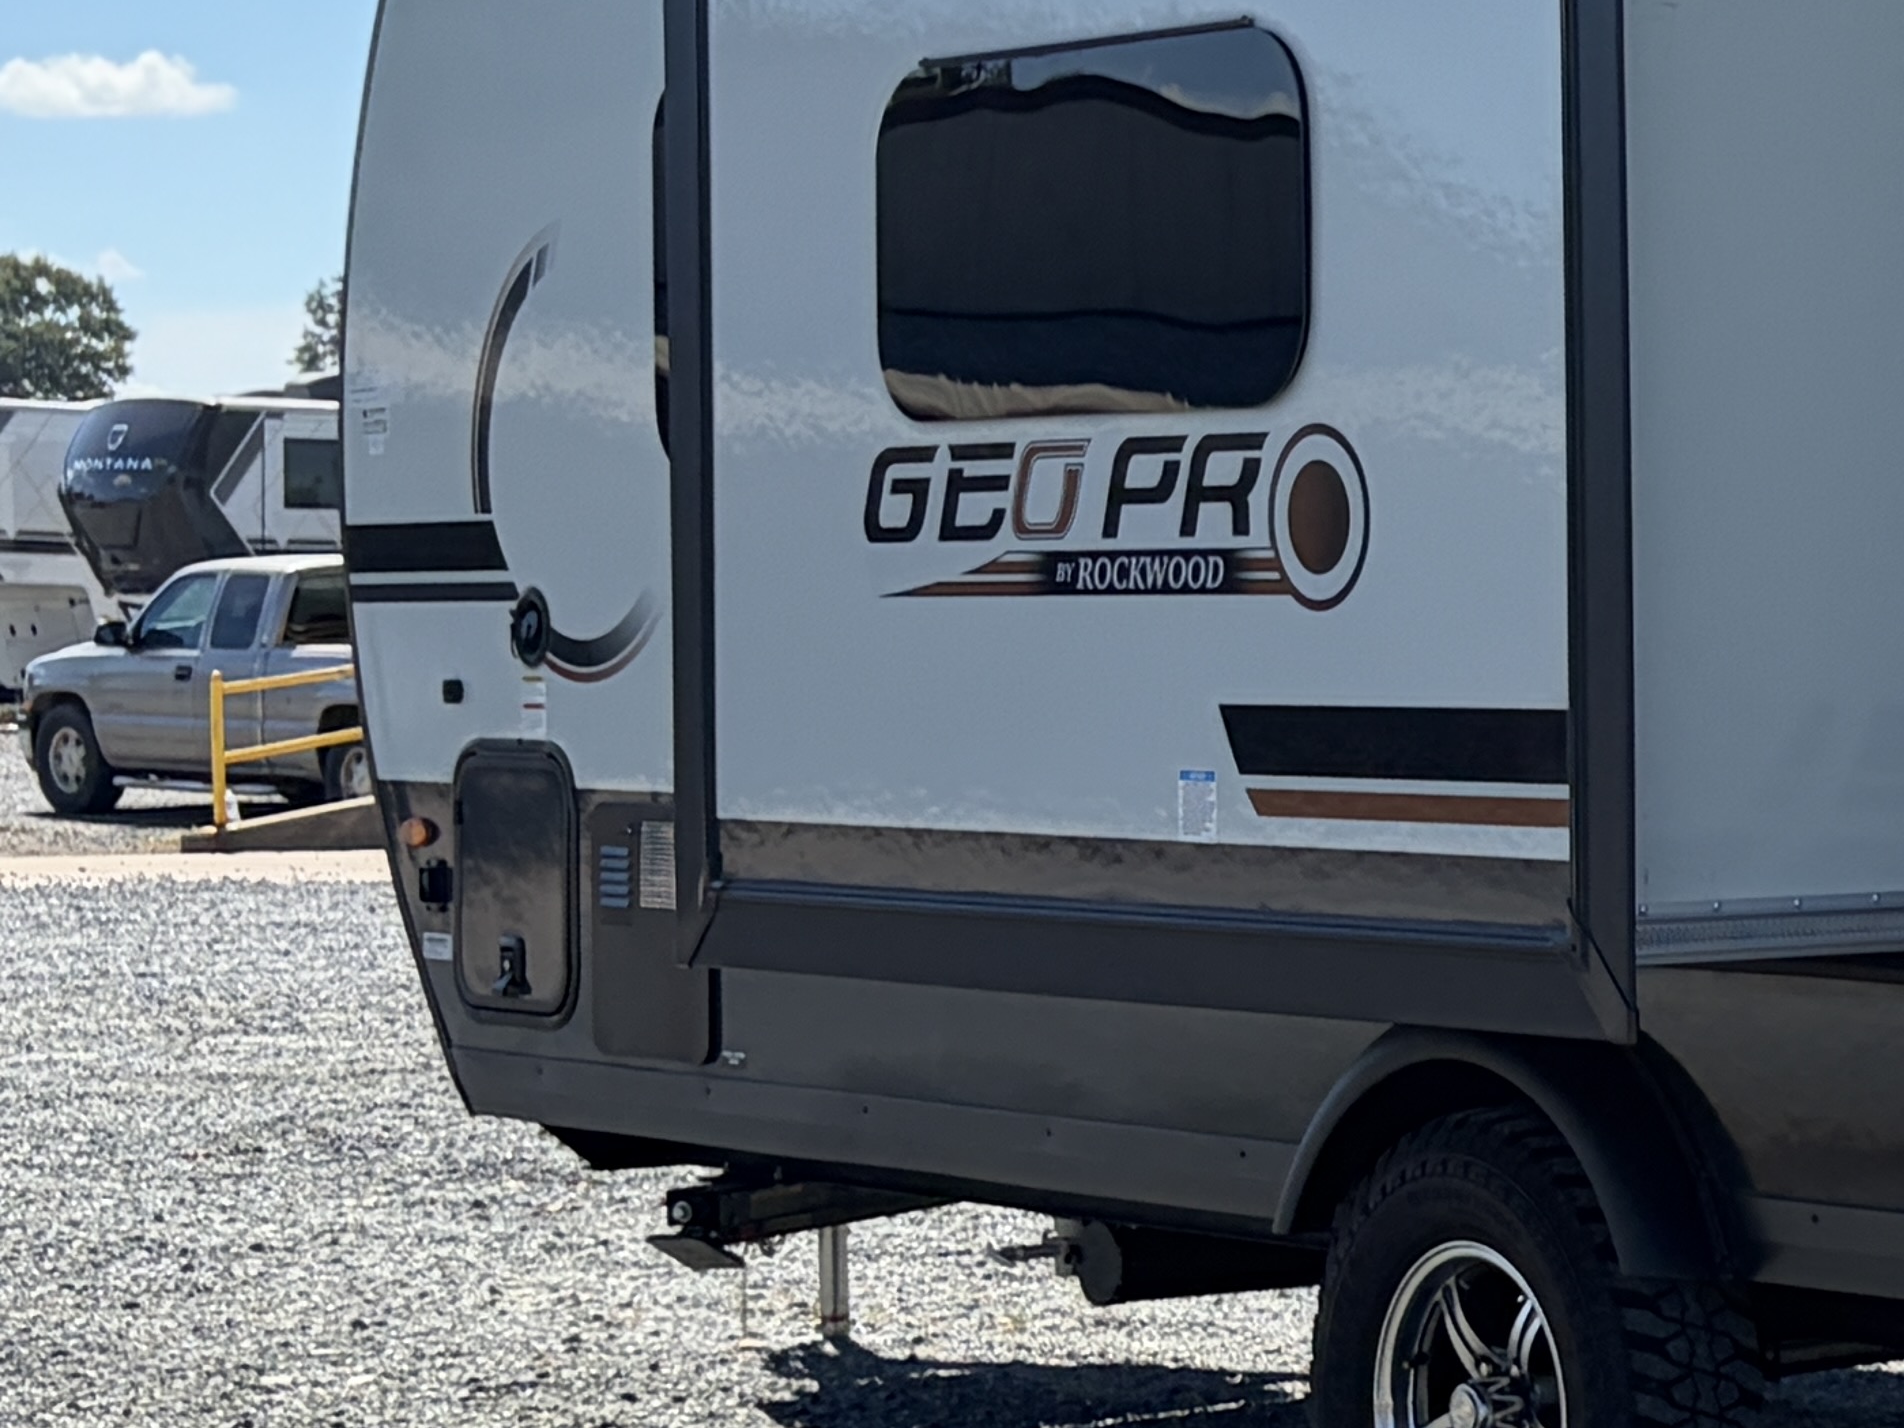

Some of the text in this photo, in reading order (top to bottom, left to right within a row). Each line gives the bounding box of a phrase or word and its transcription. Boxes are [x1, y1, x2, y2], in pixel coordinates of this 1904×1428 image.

[73, 457, 153, 470] MONTANA
[863, 438, 1092, 543] GEO
[1054, 554, 1226, 591] BY ROCKWOOD
